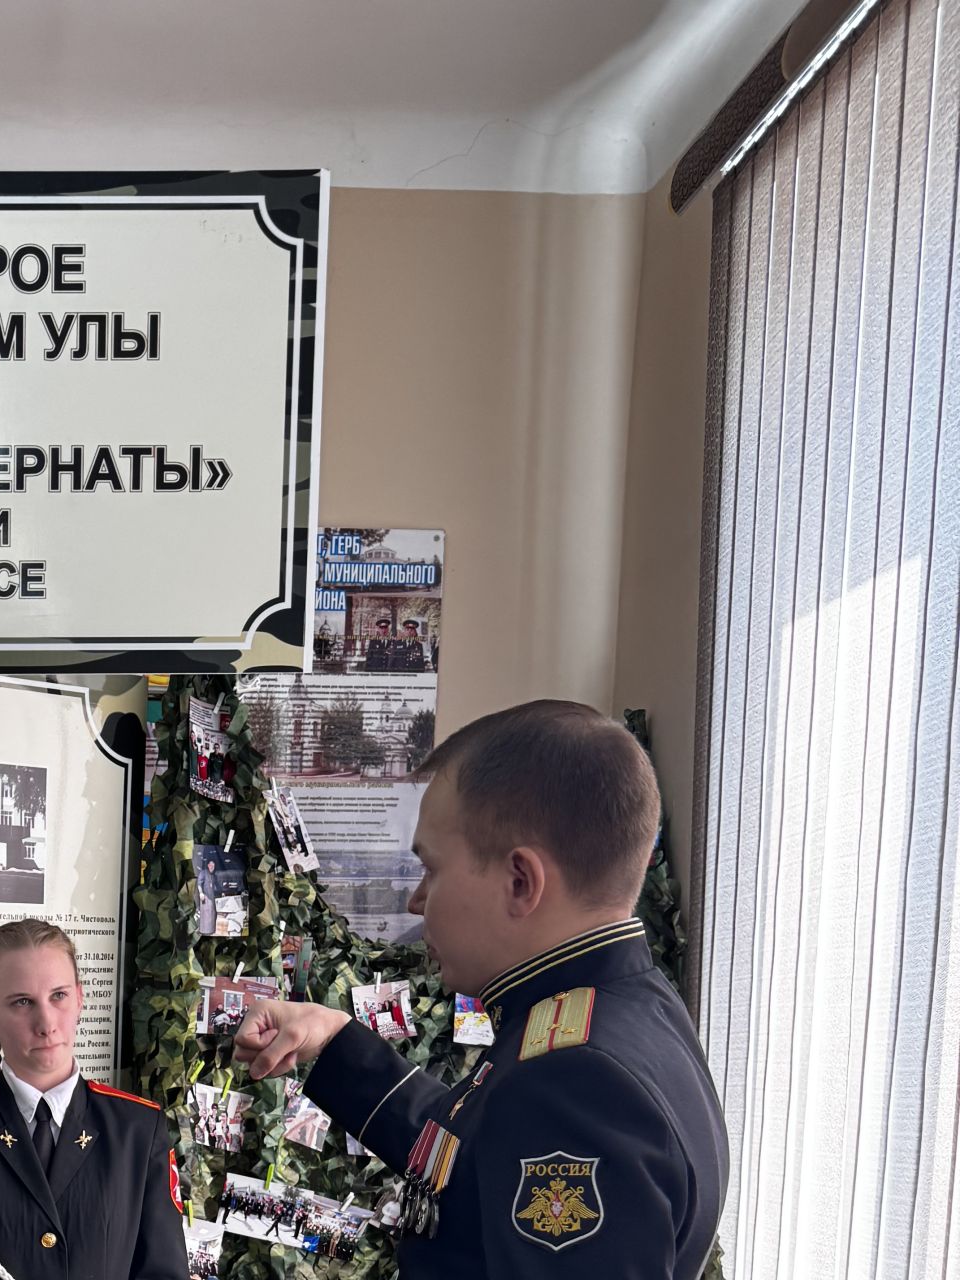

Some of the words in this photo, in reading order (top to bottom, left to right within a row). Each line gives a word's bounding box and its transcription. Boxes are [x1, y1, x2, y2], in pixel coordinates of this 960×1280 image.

[40, 311, 160, 361] УЛЫ
[331, 535, 361, 555] ГЕРБ
[324, 563, 436, 585] МУНИЦИПАЛЬНОГО
[315, 588, 346, 610] ЙОНА
[64, 914, 72, 922] 17
[81, 914, 116, 923] Чистополь
[84, 953, 114, 961] 31.10.2014
[91, 978, 113, 988] Сергея
[91, 990, 113, 998] МБОУ
[525, 1163, 591, 1176] РОССИЯ
